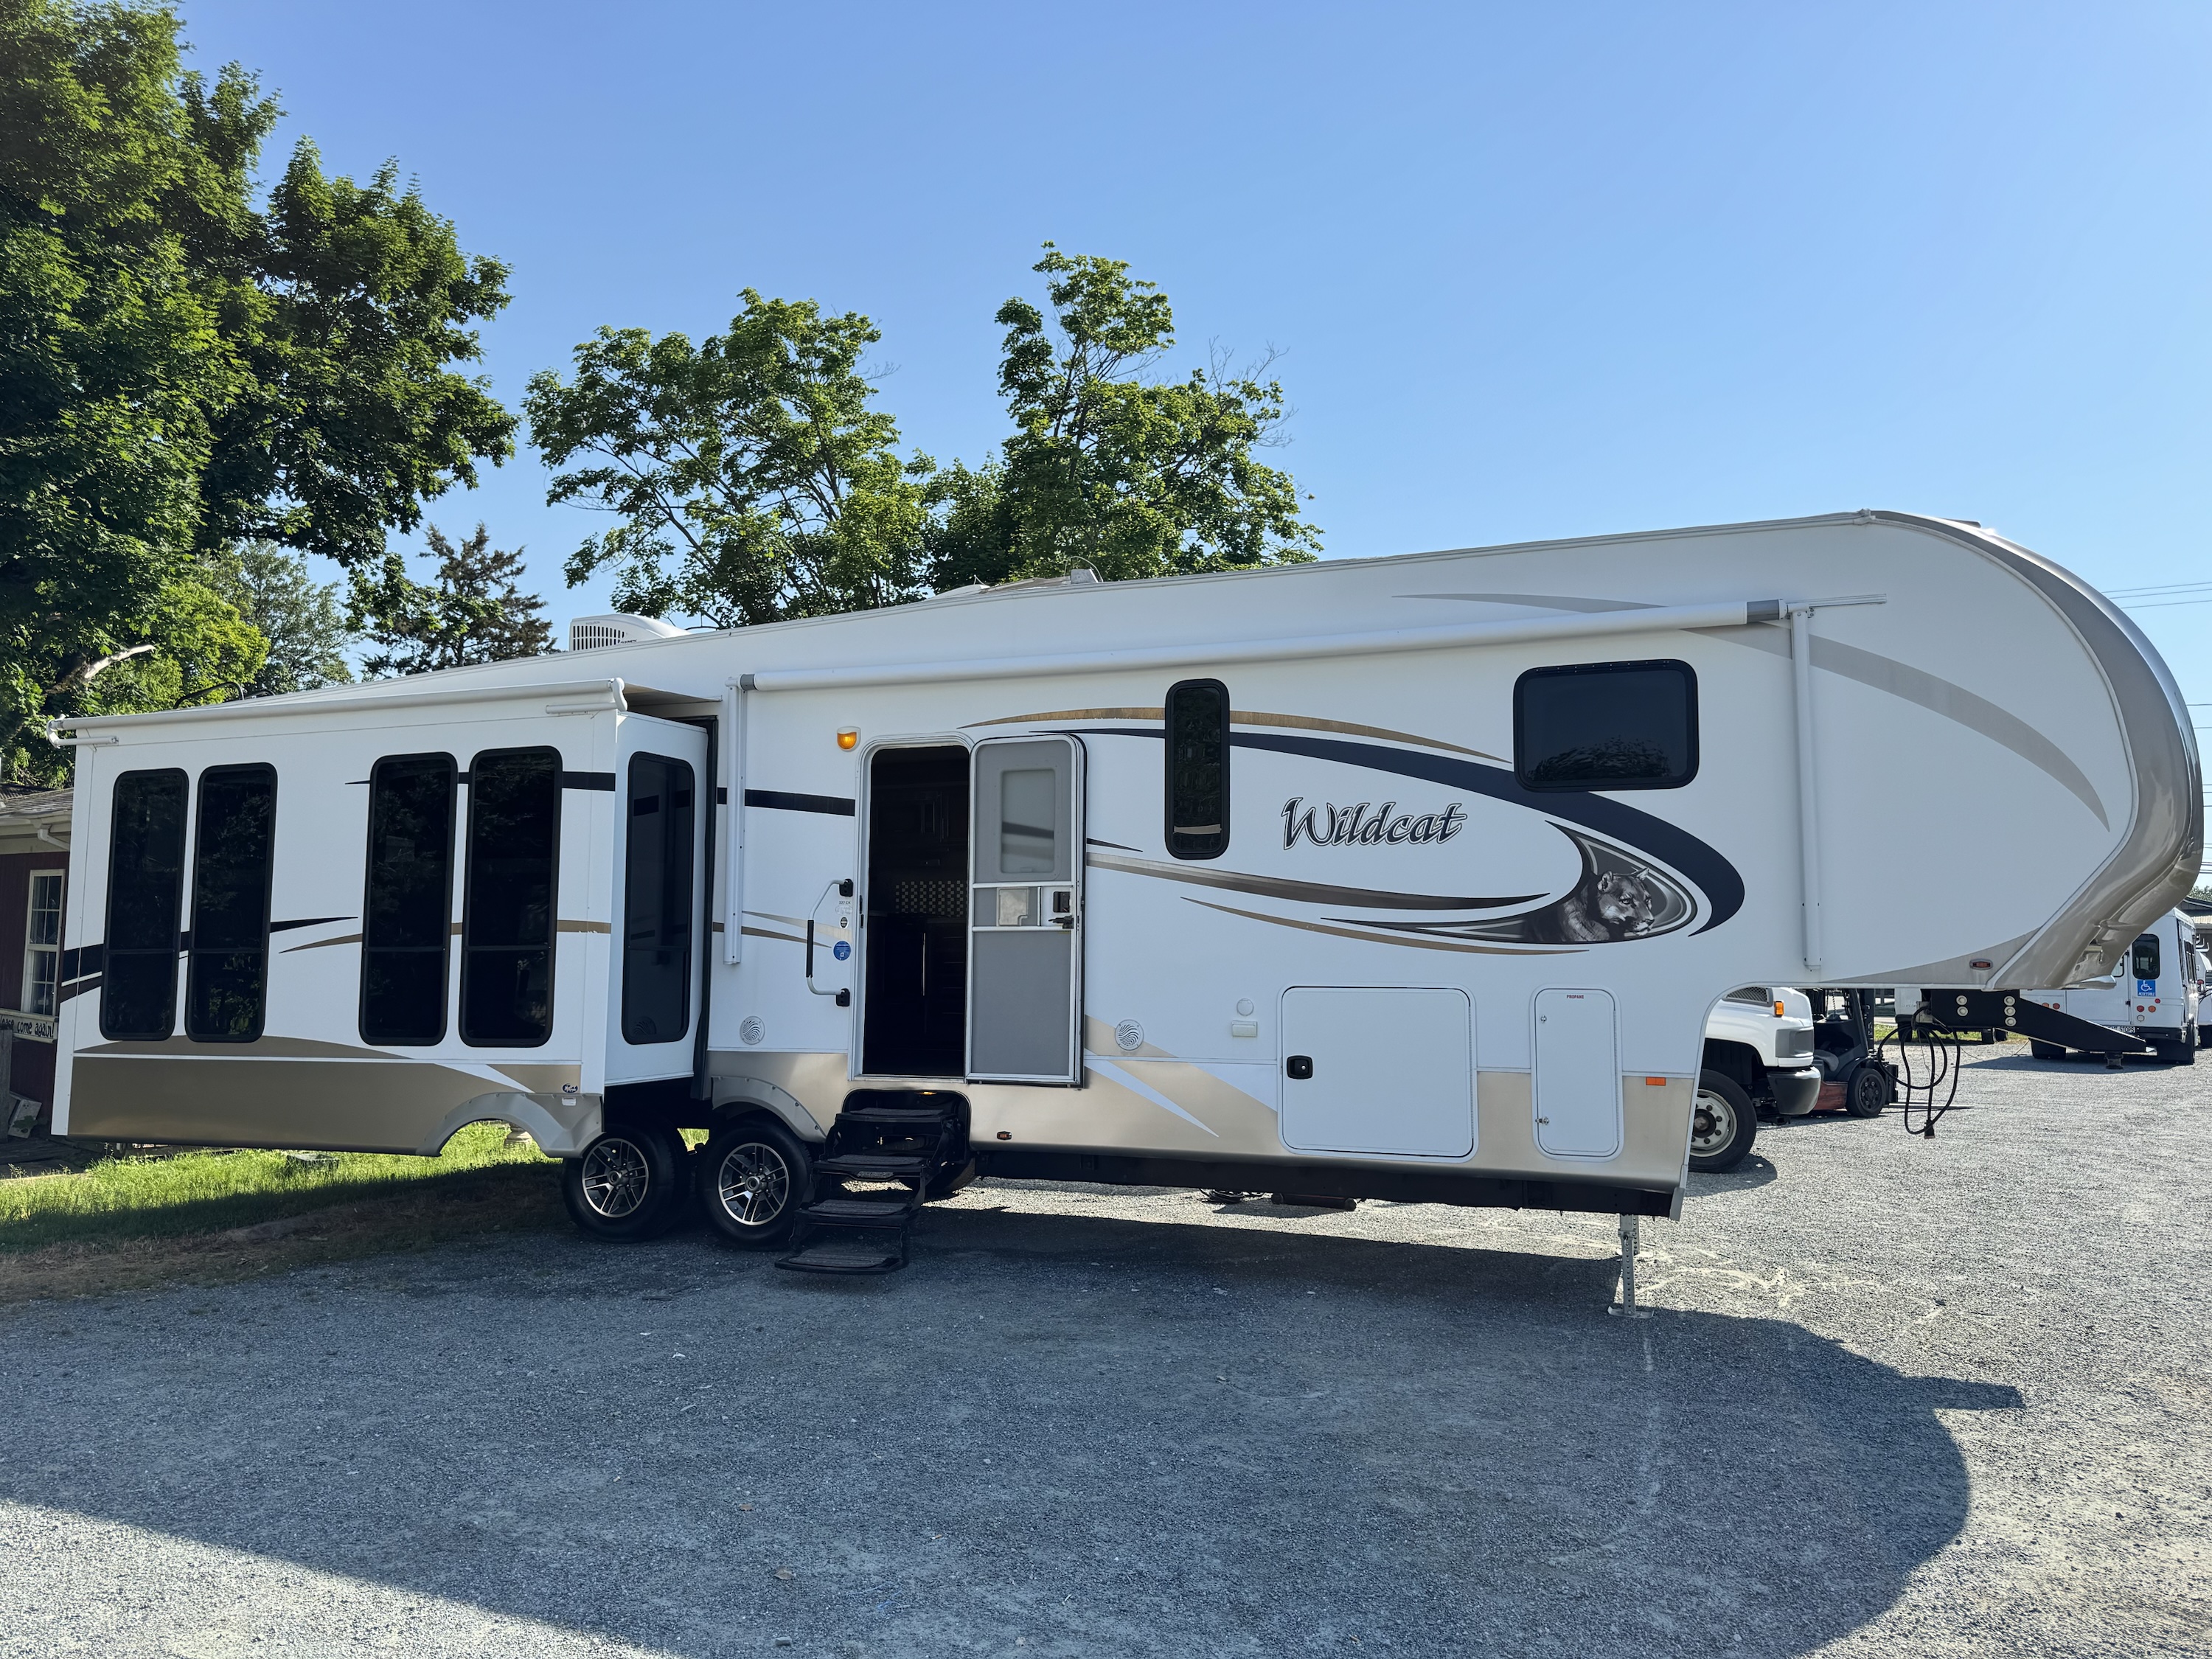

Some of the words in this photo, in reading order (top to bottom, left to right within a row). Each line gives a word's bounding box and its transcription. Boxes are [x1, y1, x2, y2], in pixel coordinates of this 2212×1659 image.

[1281, 797, 1467, 850] Wildcat
[17, 1021, 32, 1034] come
[34, 1021, 55, 1038] again!
